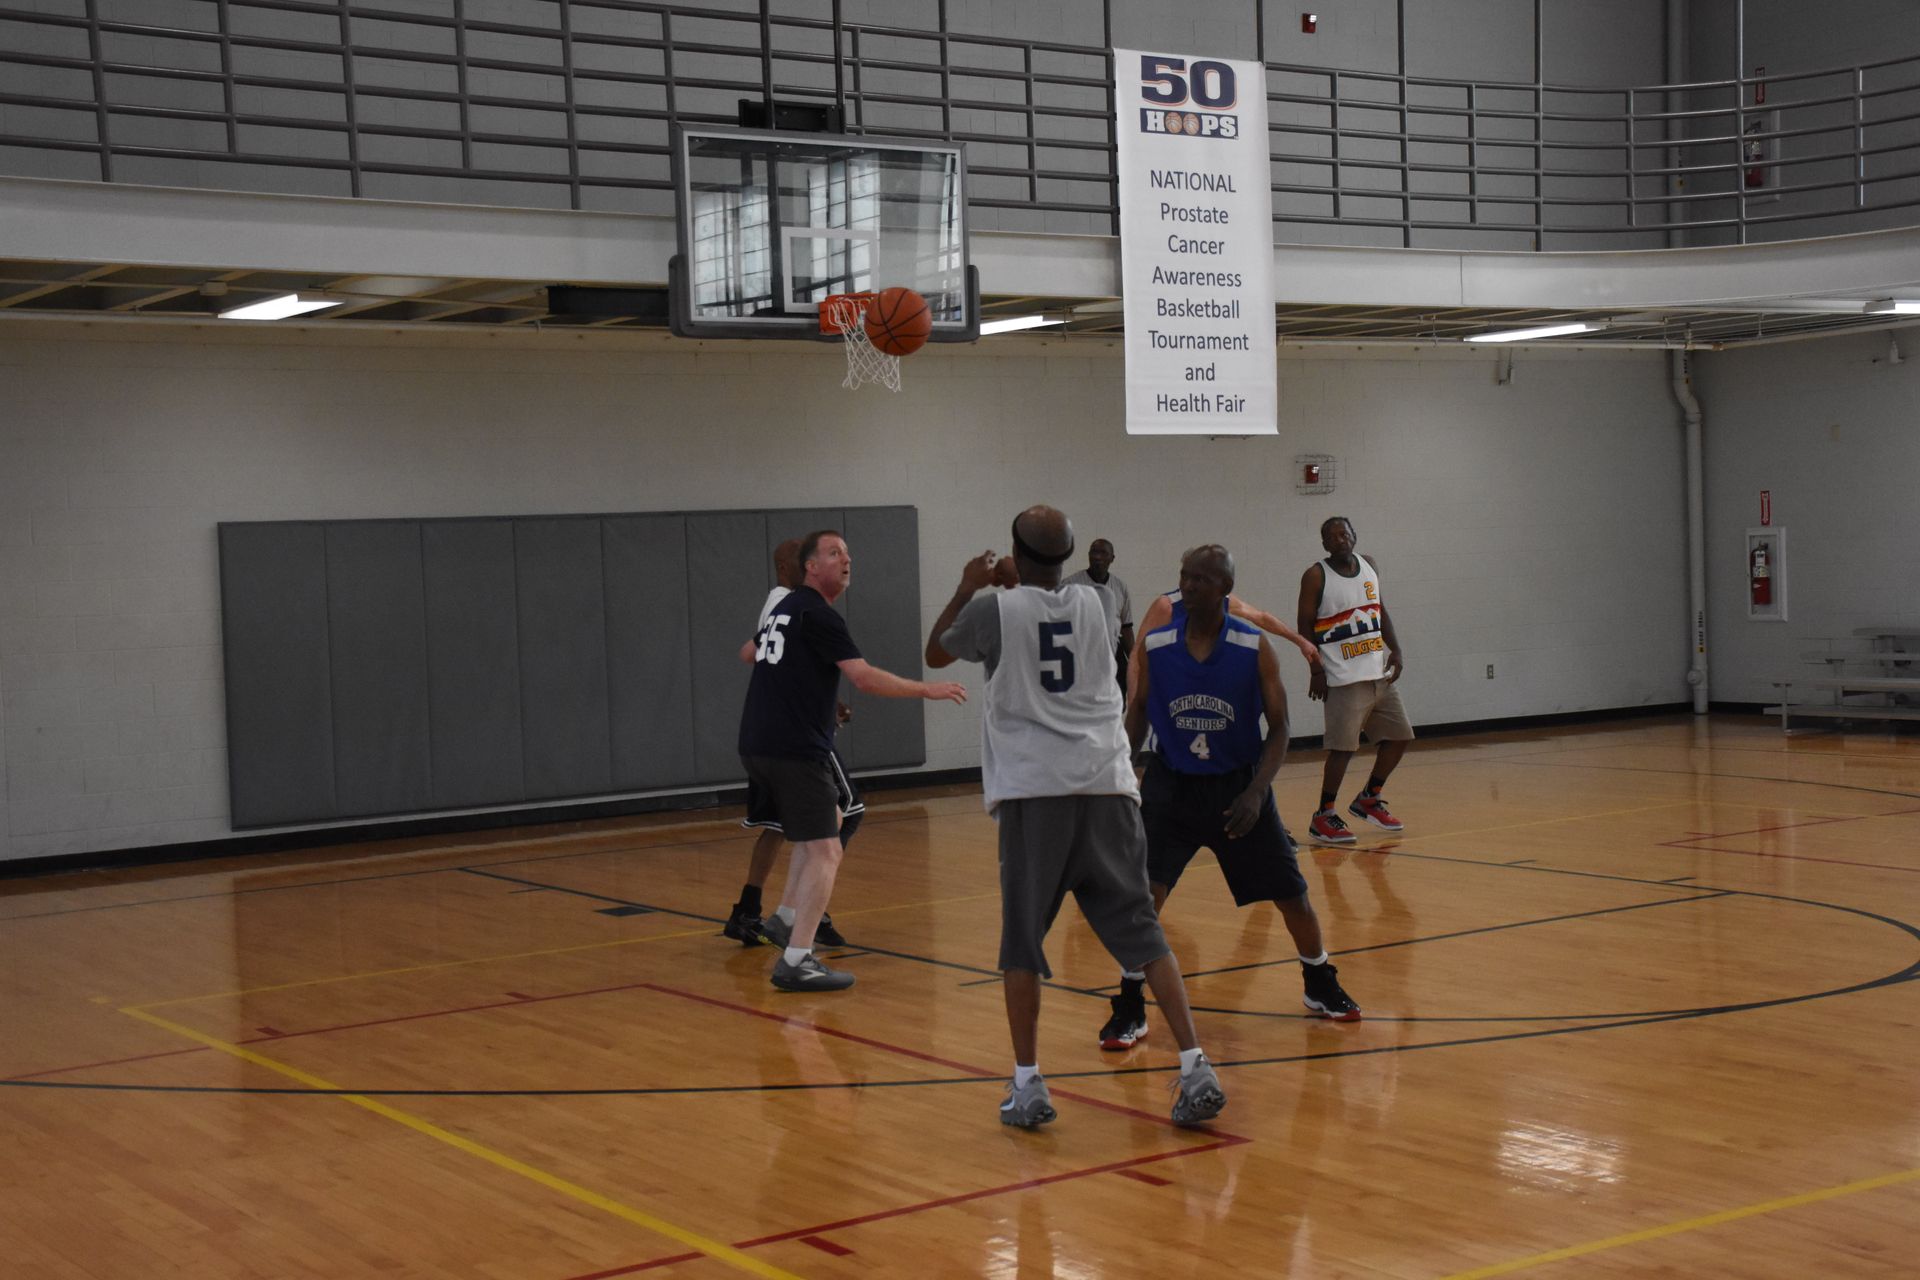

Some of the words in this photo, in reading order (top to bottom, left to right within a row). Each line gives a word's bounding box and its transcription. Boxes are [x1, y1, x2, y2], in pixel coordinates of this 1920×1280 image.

[1141, 55, 1237, 110] 50
[1145, 110, 1236, 137] HOOPS
[1151, 169, 1236, 193] NATIONAL
[1161, 203, 1229, 224] Prostate
[1168, 234, 1225, 255] Cancer
[1152, 266, 1242, 287] Awareness
[1157, 298, 1240, 319] Basketball
[1148, 330, 1249, 350] Tournament
[1185, 362, 1215, 381] and
[1156, 393, 1211, 413] Health
[1216, 394, 1246, 413] Fair
[1364, 581, 1376, 600] 2
[1039, 621, 1074, 693] 5
[1194, 693, 1235, 722] CAROLINA
[1176, 716, 1227, 731] SENIORS
[1189, 733, 1210, 760] 4
